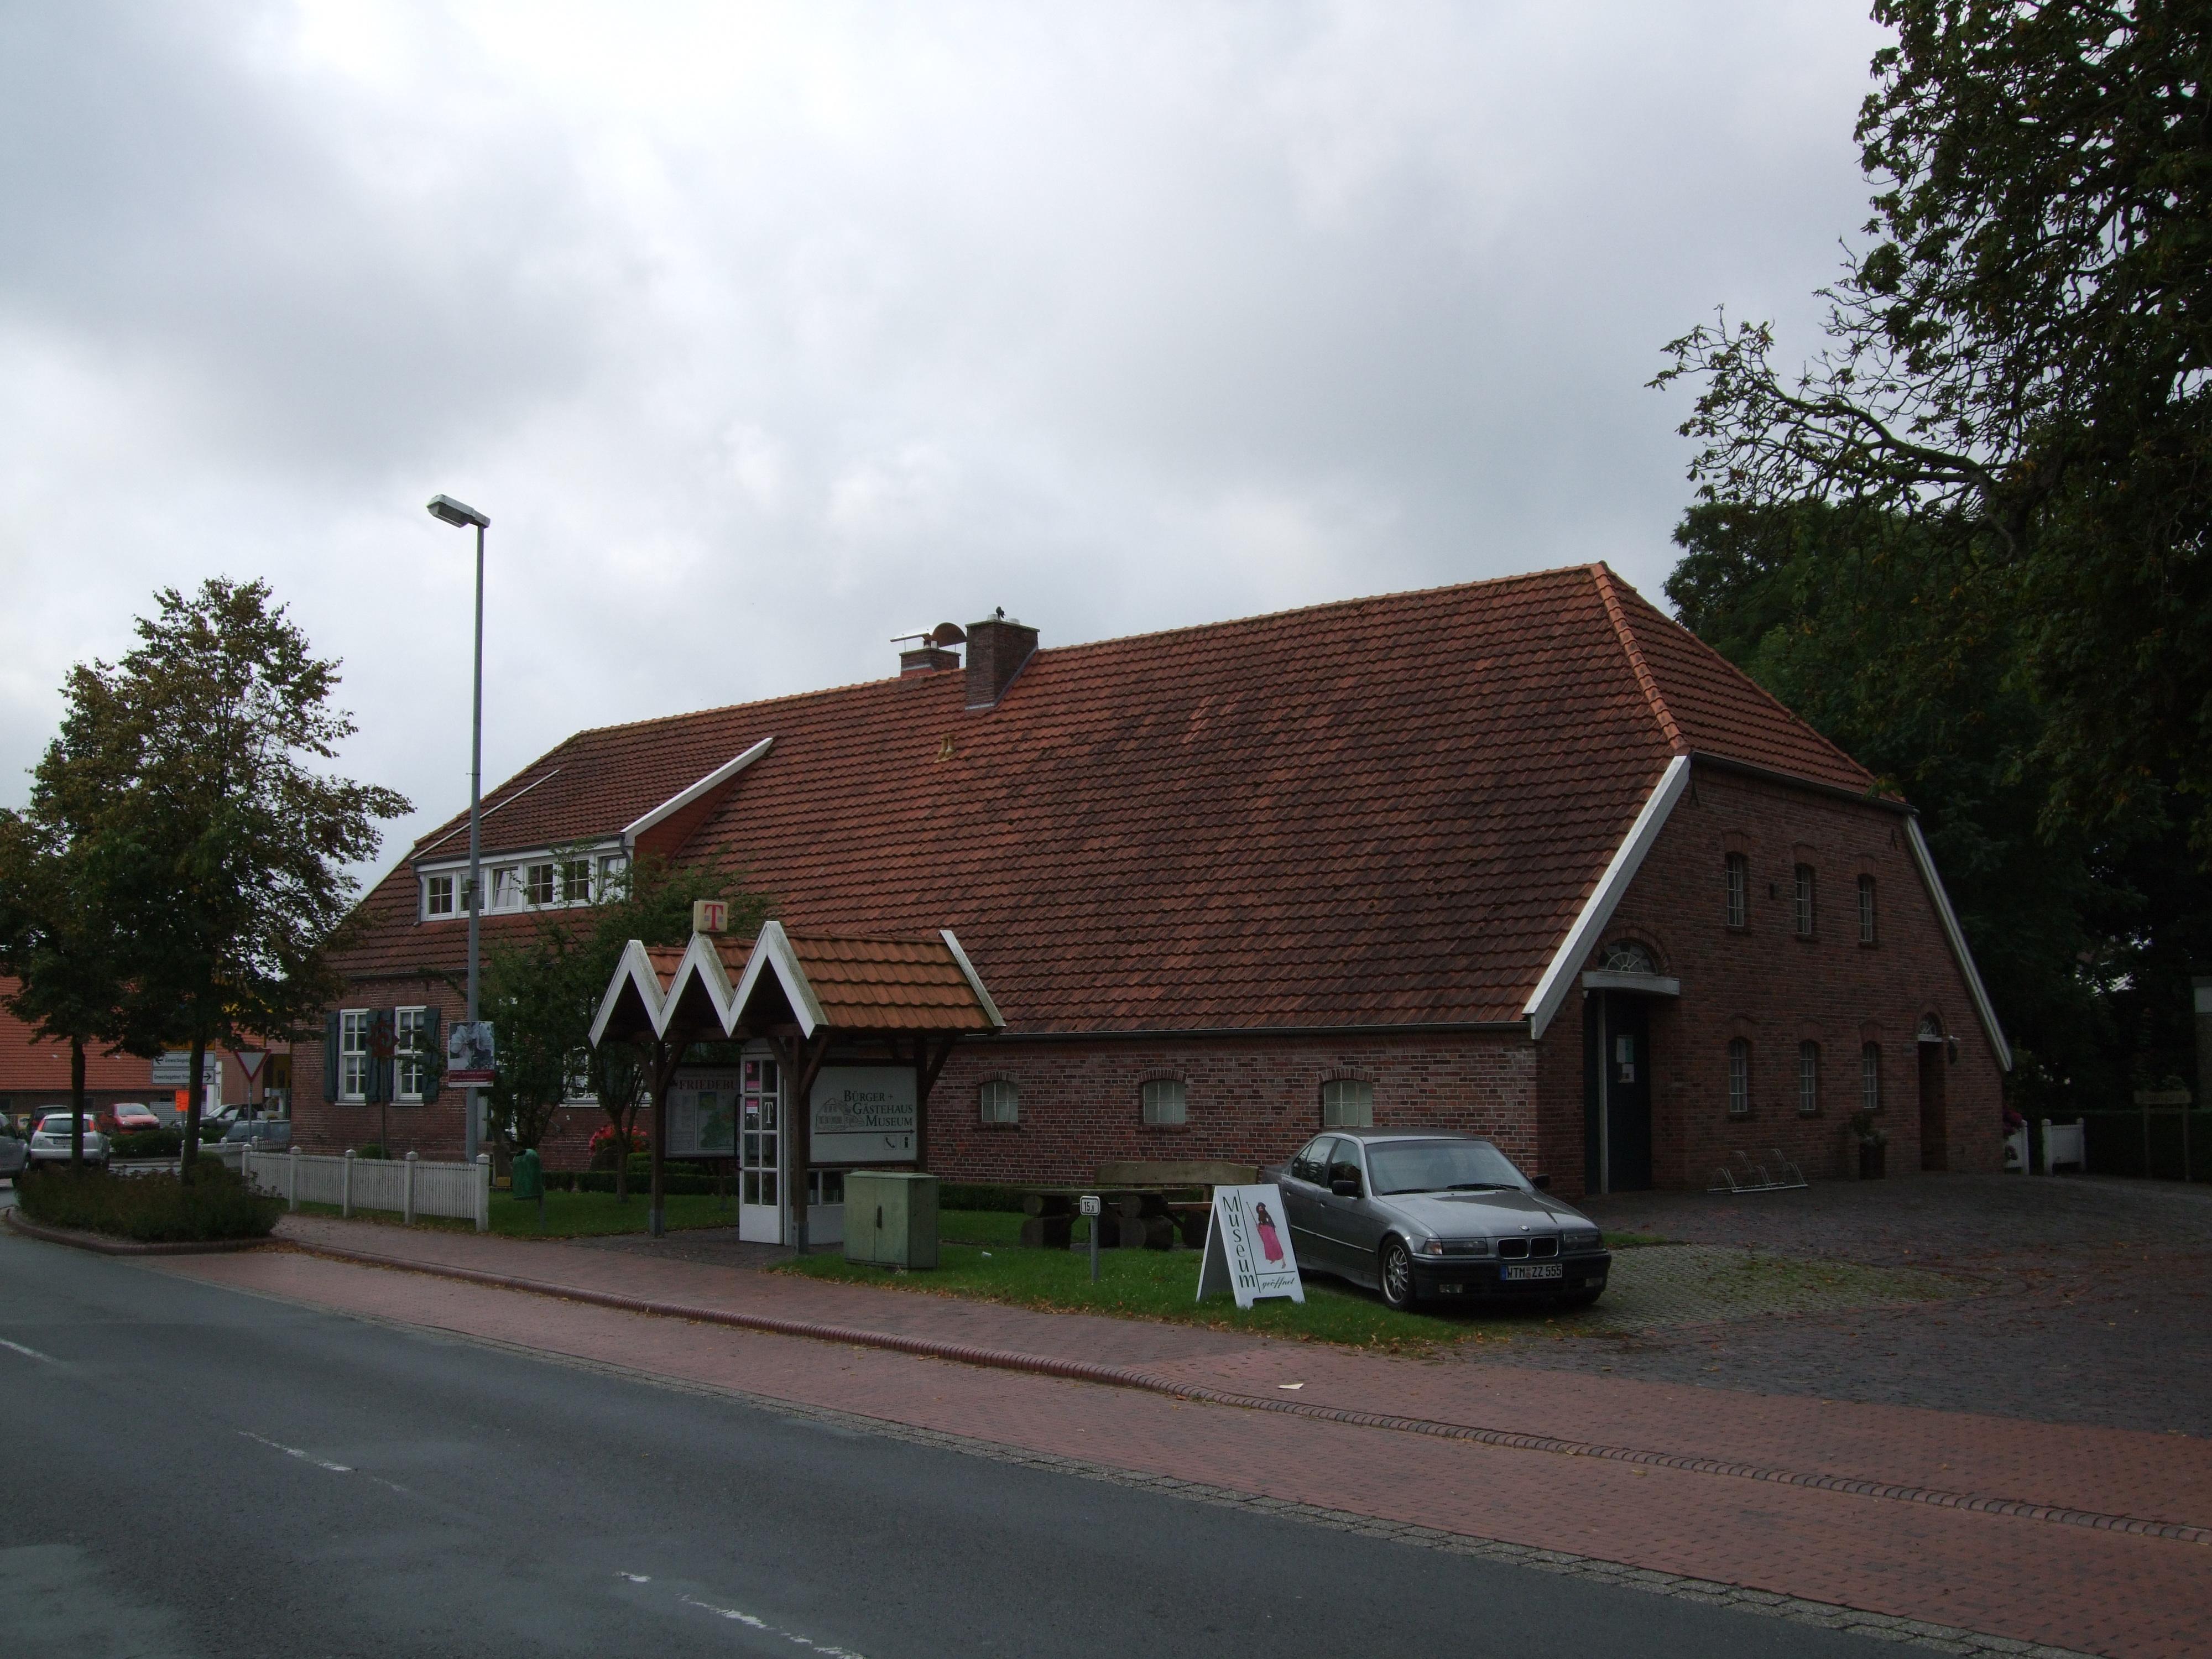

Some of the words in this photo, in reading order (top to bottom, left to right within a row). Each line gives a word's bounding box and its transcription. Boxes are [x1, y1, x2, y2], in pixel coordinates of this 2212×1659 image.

[704, 904, 724, 930] T
[844, 1090, 885, 1102] BÜRGER
[853, 1102, 913, 1115] GÄSTEHAUS
[866, 1115, 912, 1126] MUSEUM
[1223, 1196, 1255, 1288] Museum
[1507, 1267, 1525, 1279] WTM
[1532, 1266, 1543, 1277] ZZ
[1546, 1265, 1561, 1277] 555
[1262, 1276, 1295, 1290] geöffnet
